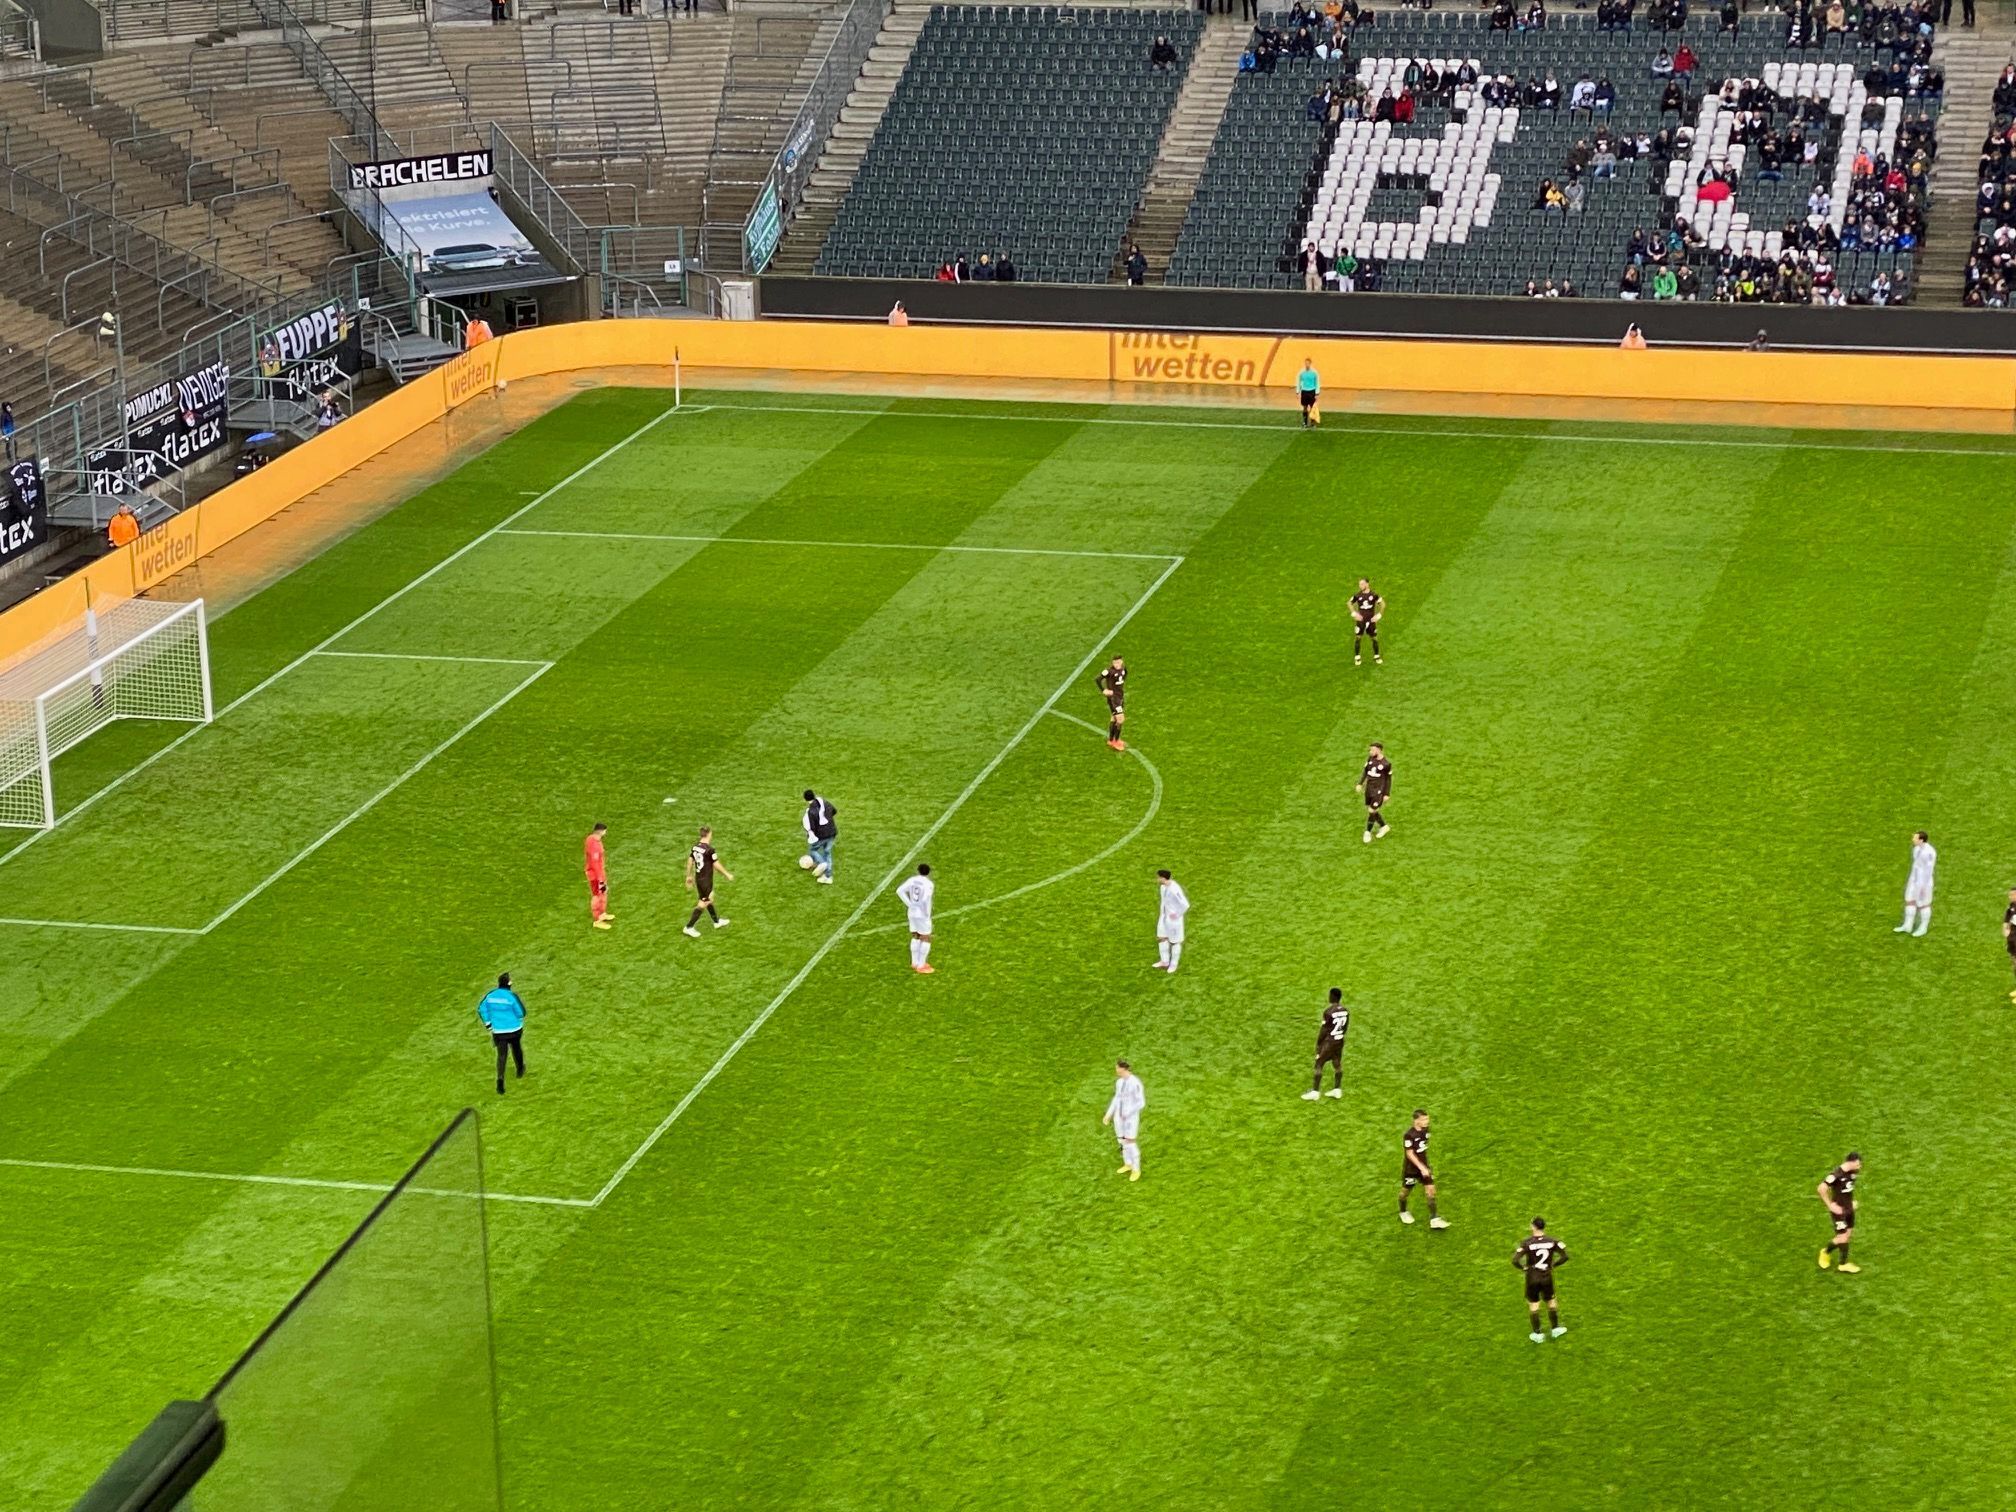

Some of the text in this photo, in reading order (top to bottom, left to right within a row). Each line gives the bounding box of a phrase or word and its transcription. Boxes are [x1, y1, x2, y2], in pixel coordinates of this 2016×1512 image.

[352, 154, 488, 188] BRACHELEN
[385, 207, 489, 225] Eektrisiert
[276, 305, 339, 367] FUPPE
[450, 361, 491, 400] wetten
[1133, 353, 1255, 381] wetten
[125, 382, 173, 424] PUMUCKL
[161, 418, 220, 466] flatex
[93, 453, 156, 495] flaex
[141, 533, 192, 581] wetten
[1534, 1248, 1550, 1270] 2
